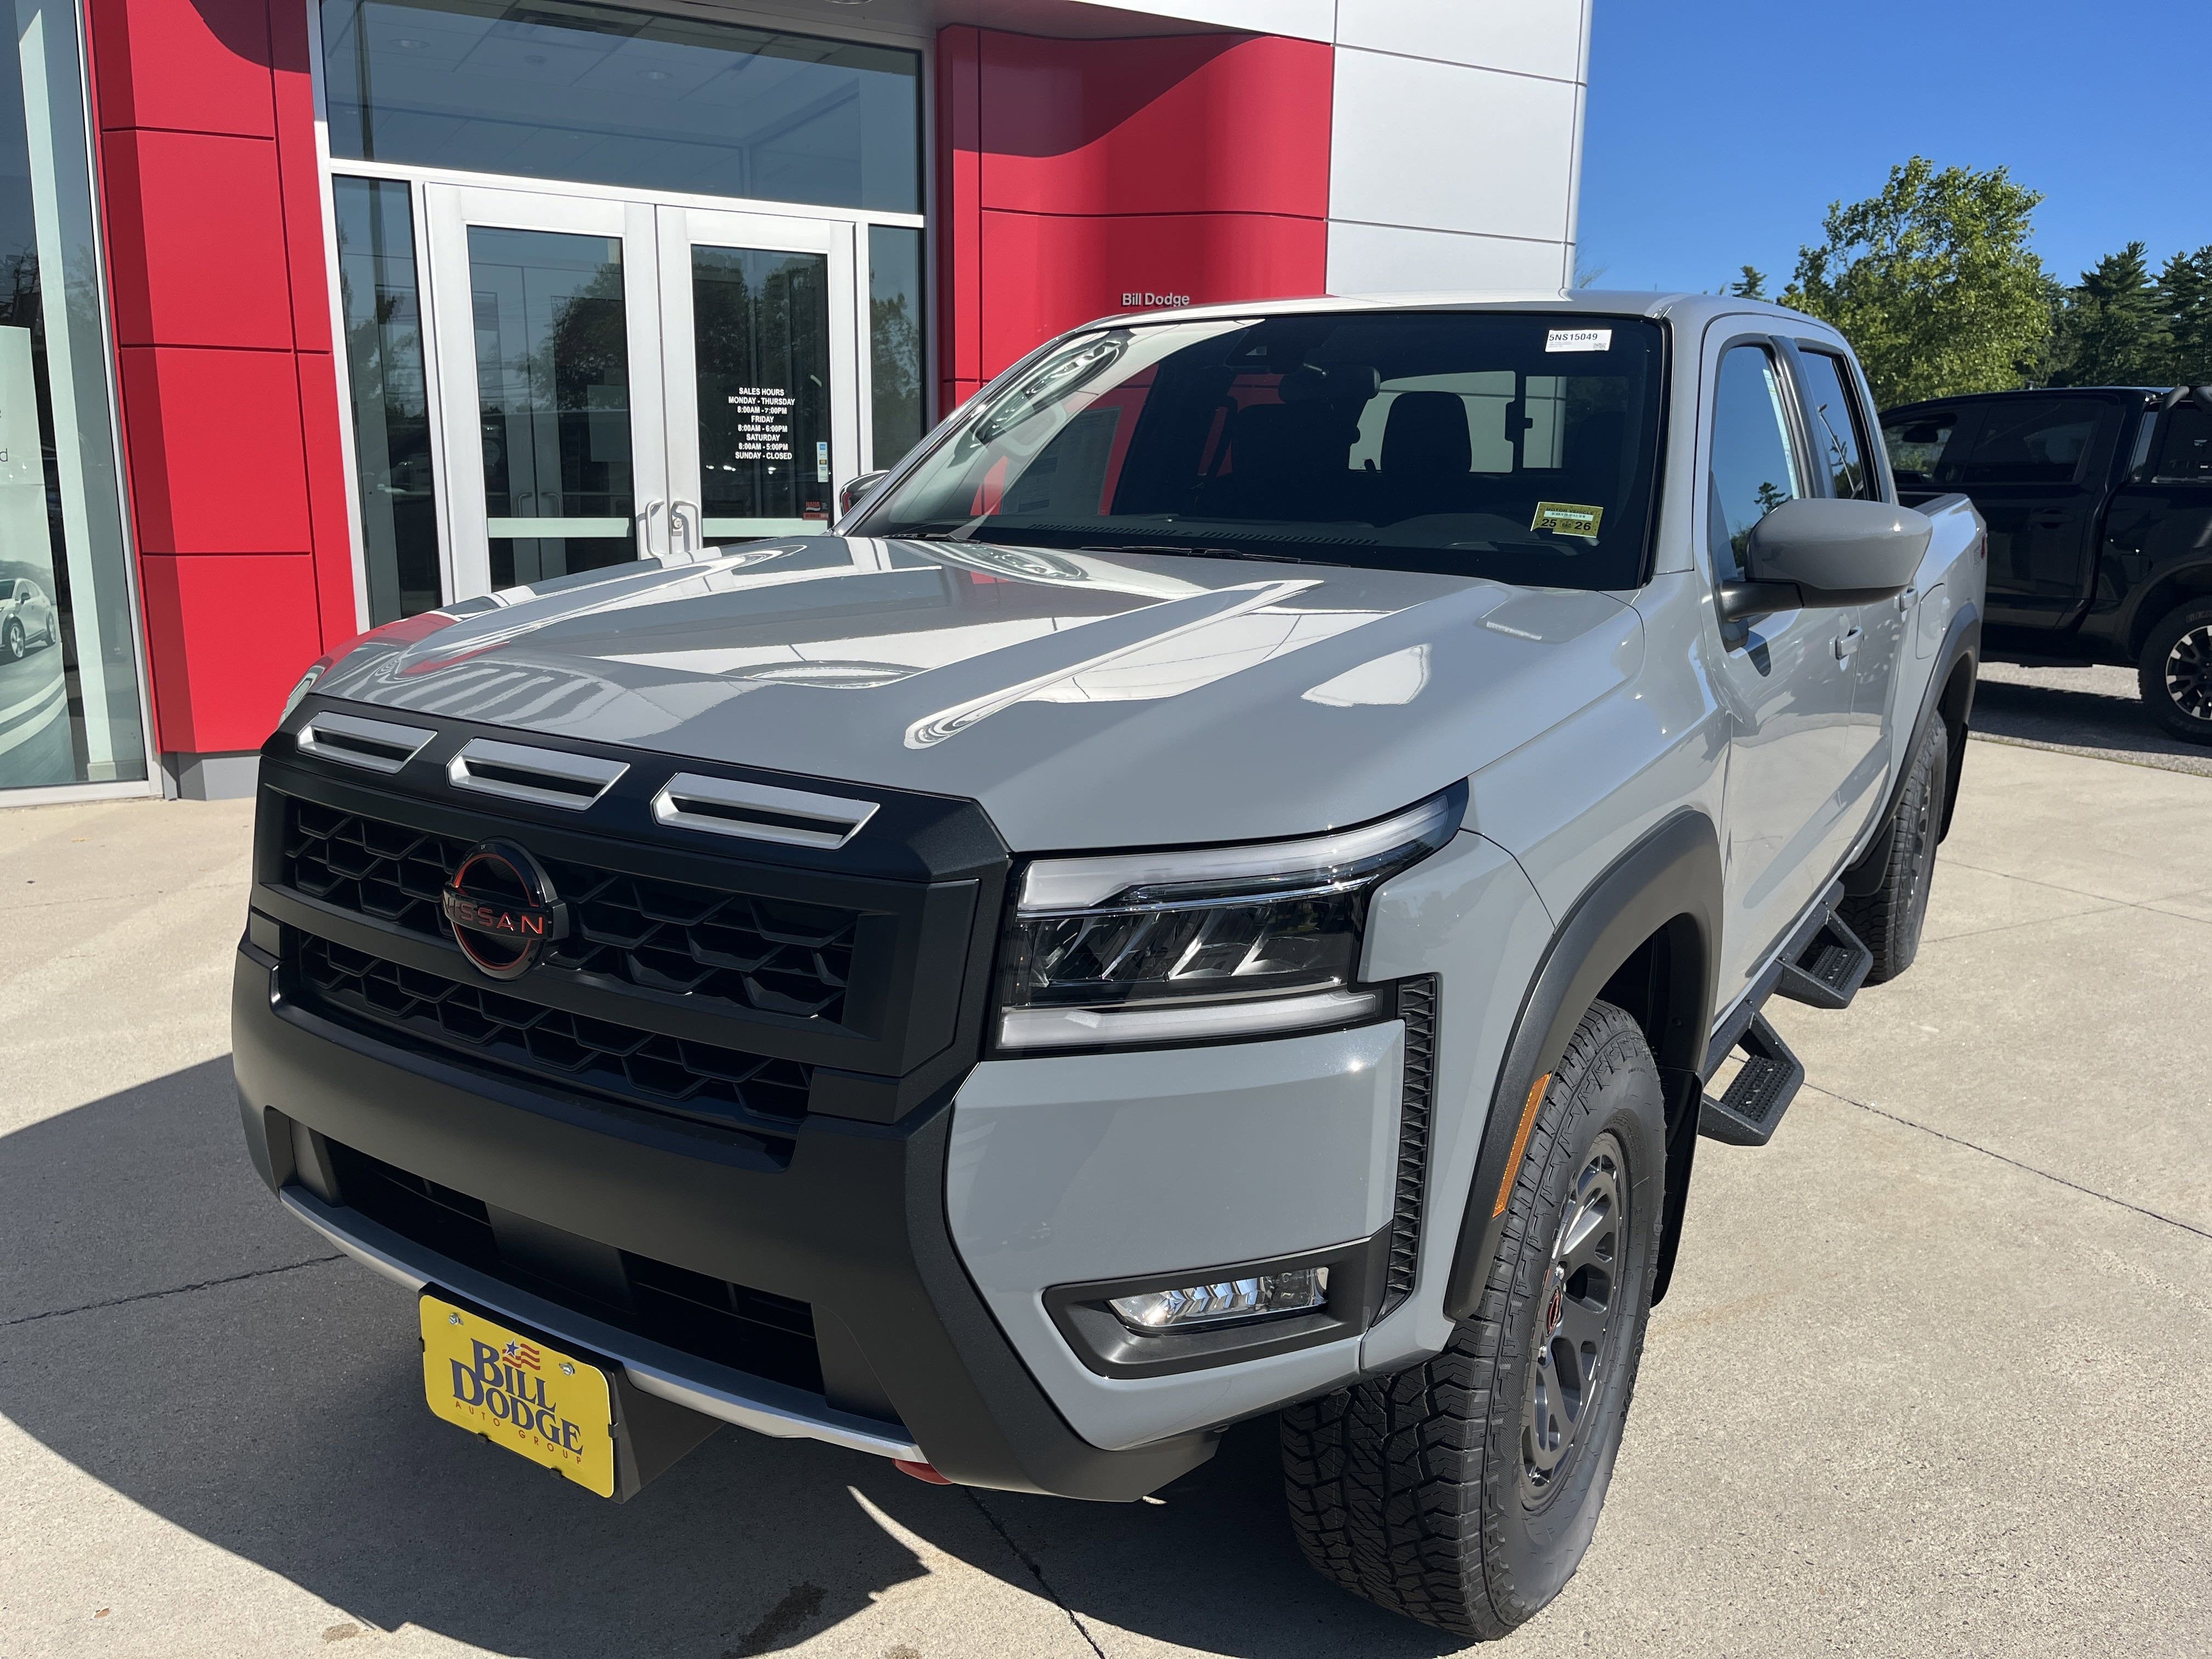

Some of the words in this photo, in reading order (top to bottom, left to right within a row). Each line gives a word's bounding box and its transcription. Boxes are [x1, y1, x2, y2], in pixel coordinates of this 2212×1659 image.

[1122, 293, 1142, 306] Bill
[1145, 292, 1190, 307] Dodge
[739, 387, 760, 395] SALES
[761, 388, 785, 396] HOURS
[728, 396, 757, 404] MONDAY
[761, 397, 795, 405] THURSDAY
[735, 452, 761, 460] SUNDAY
[1541, 518, 1558, 527] 25
[1574, 522, 1592, 531] 26
[442, 896, 543, 934] NISSAN
[471, 1338, 556, 1413] BILL
[449, 1358, 584, 1455] DODGE
[455, 1400, 500, 1426] AUTO
[518, 1429, 582, 1464] GROUP
